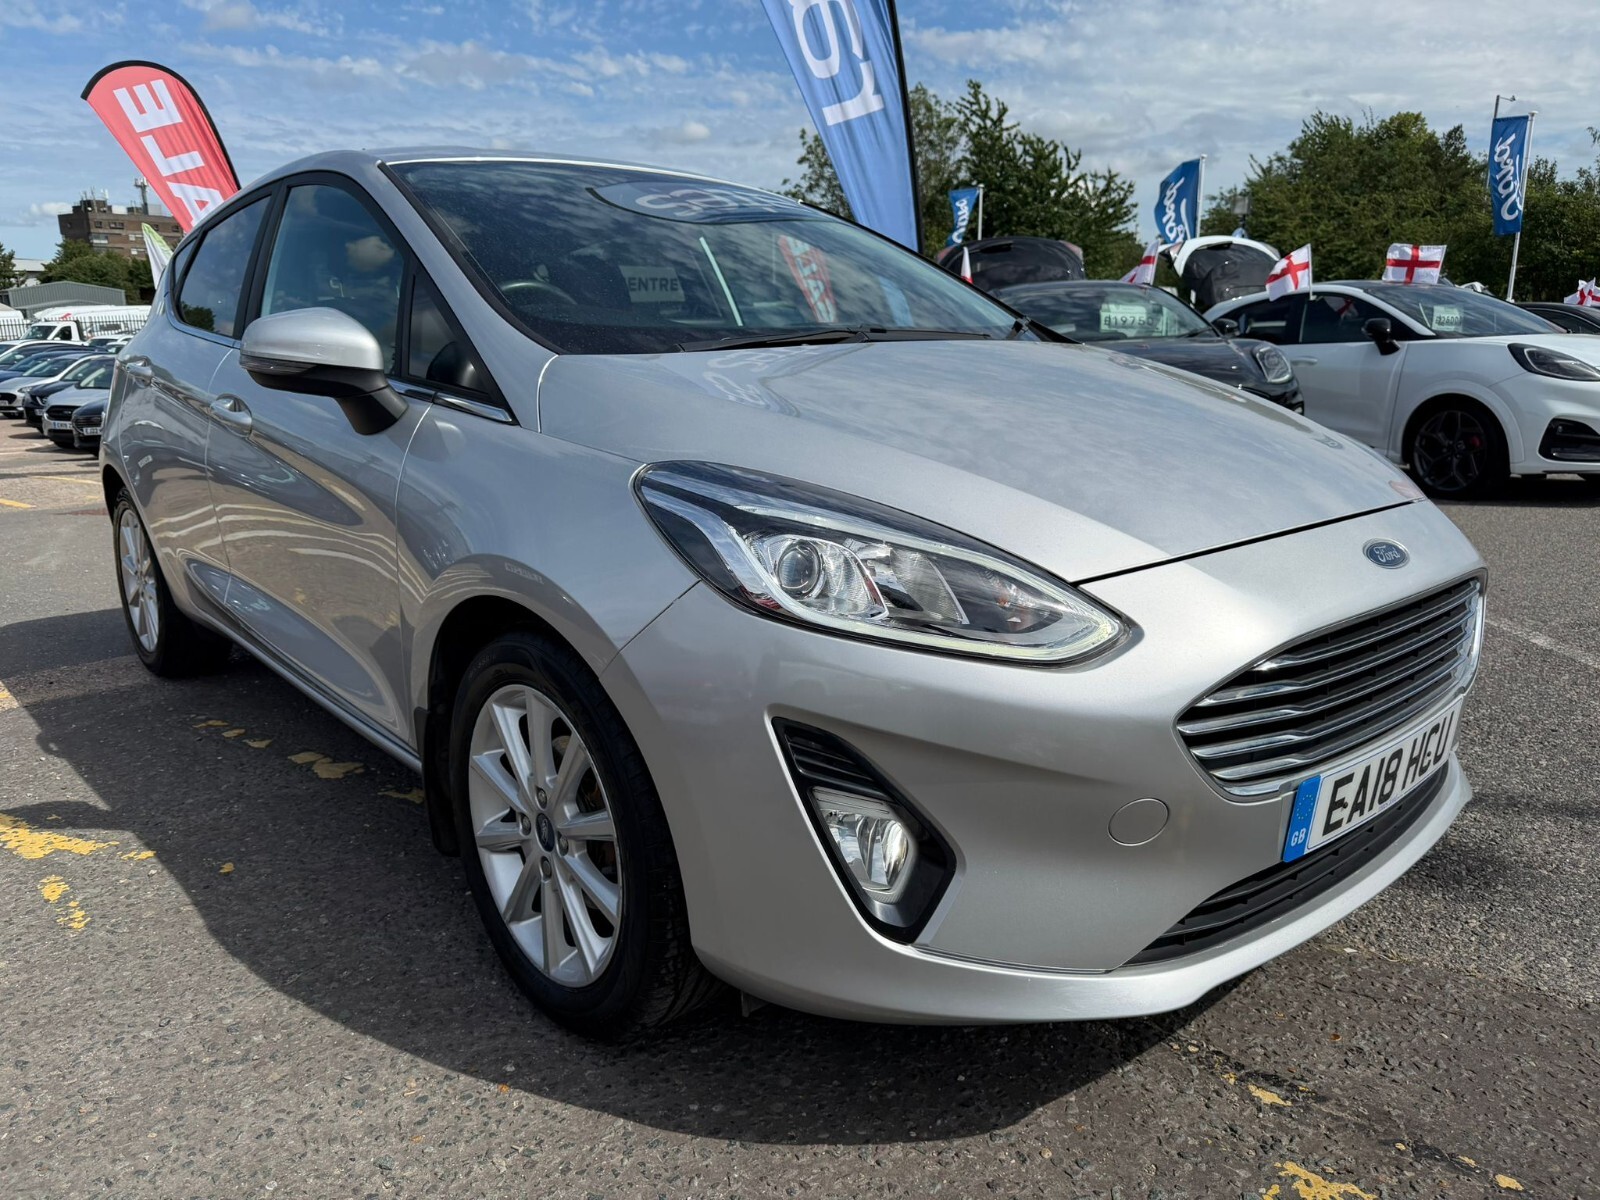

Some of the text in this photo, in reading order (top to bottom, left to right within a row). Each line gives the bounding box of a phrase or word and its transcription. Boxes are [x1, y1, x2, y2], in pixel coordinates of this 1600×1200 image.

[1373, 545, 1401, 563] Ford
[1321, 709, 1456, 837] EA18 HCU
[1290, 827, 1307, 847] GB
